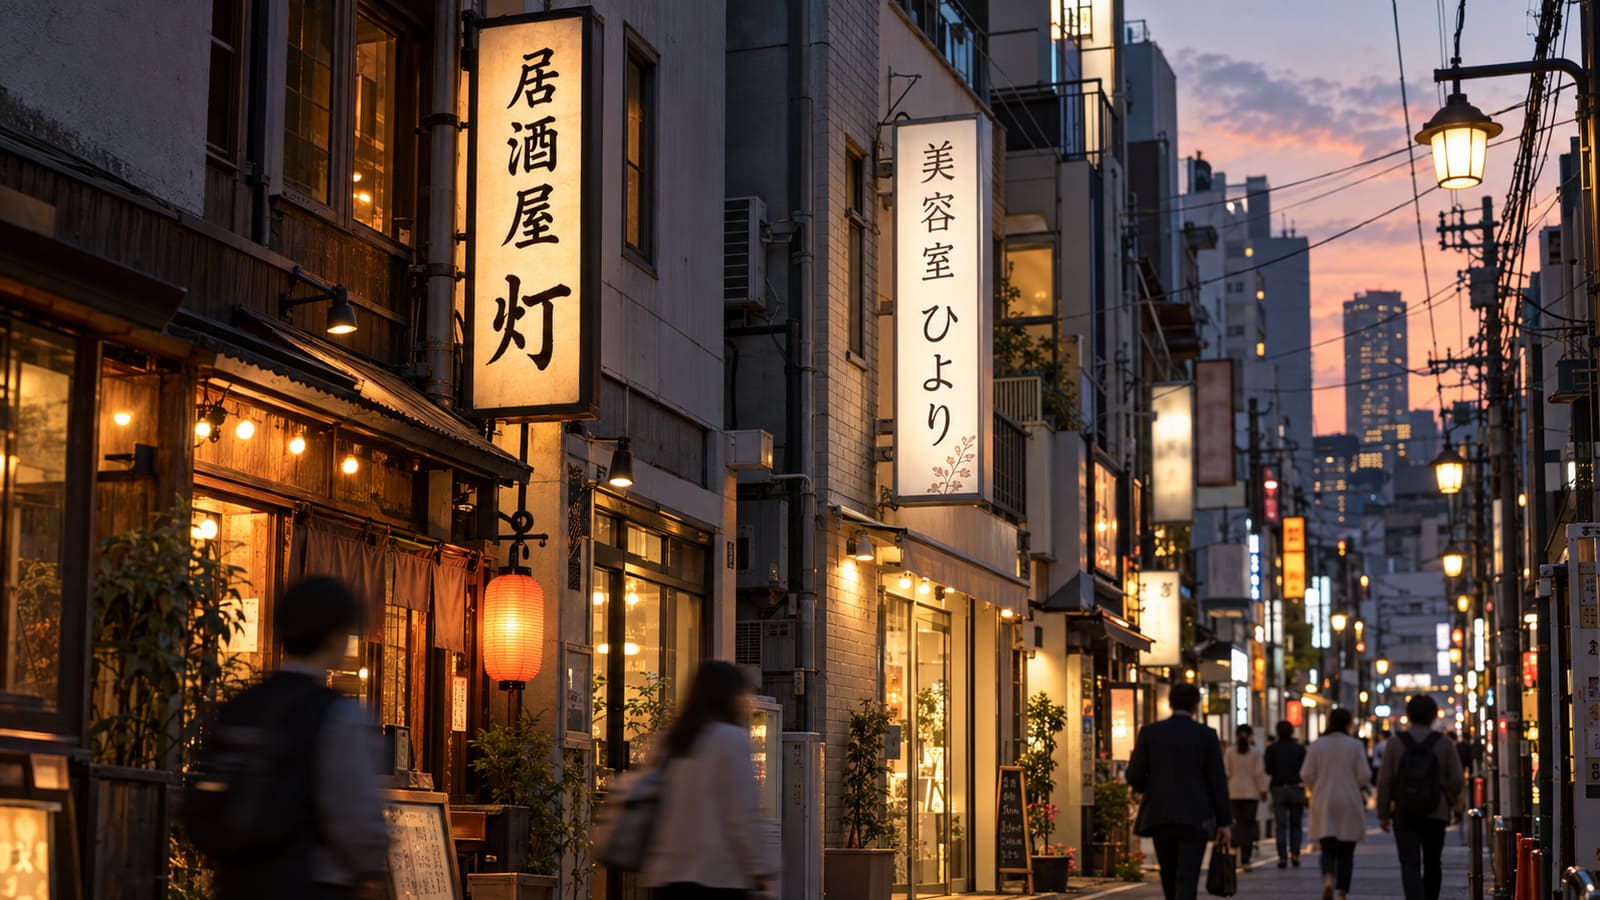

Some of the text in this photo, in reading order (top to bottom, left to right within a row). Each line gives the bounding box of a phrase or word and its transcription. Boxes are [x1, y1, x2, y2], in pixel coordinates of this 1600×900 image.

[486, 48, 571, 371] 居酒屋 灯
[921, 141, 958, 447] 美容室 ひより
